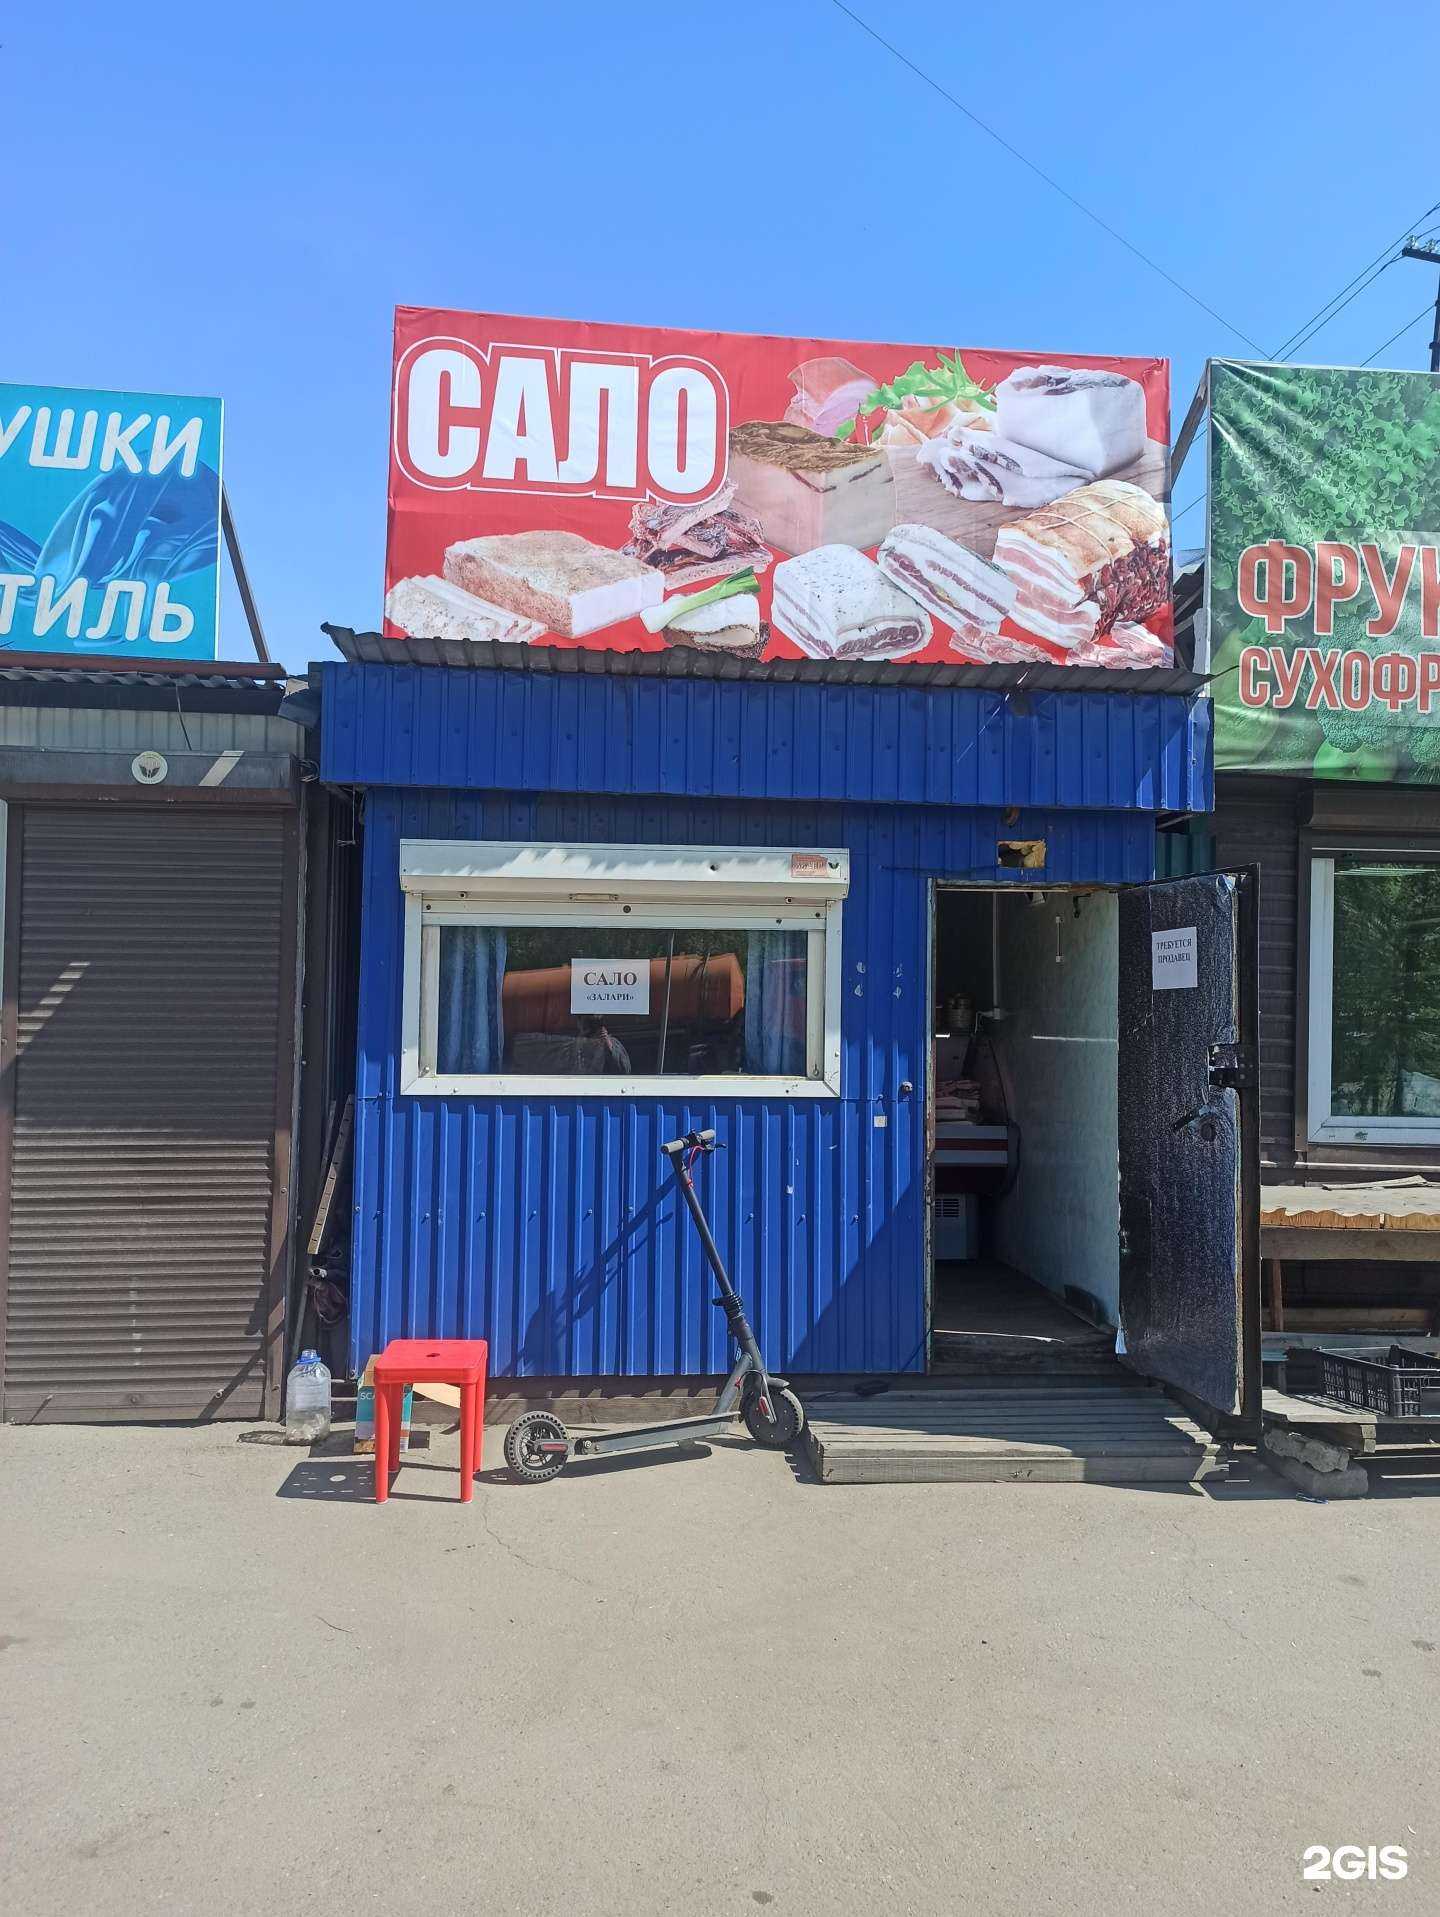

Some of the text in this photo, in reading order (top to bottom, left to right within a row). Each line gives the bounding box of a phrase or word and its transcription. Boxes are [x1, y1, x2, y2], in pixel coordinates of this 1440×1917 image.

[406, 347, 719, 496] САЛО
[0, 573, 196, 644] ТИЛЬ
[1238, 645, 1440, 713] СУХОФР
[1156, 938, 1192, 950] ТРЕБУЕТСЯ
[1157, 952, 1191, 964] ПРОДАВЕЦ
[583, 971, 638, 986] САЛО
